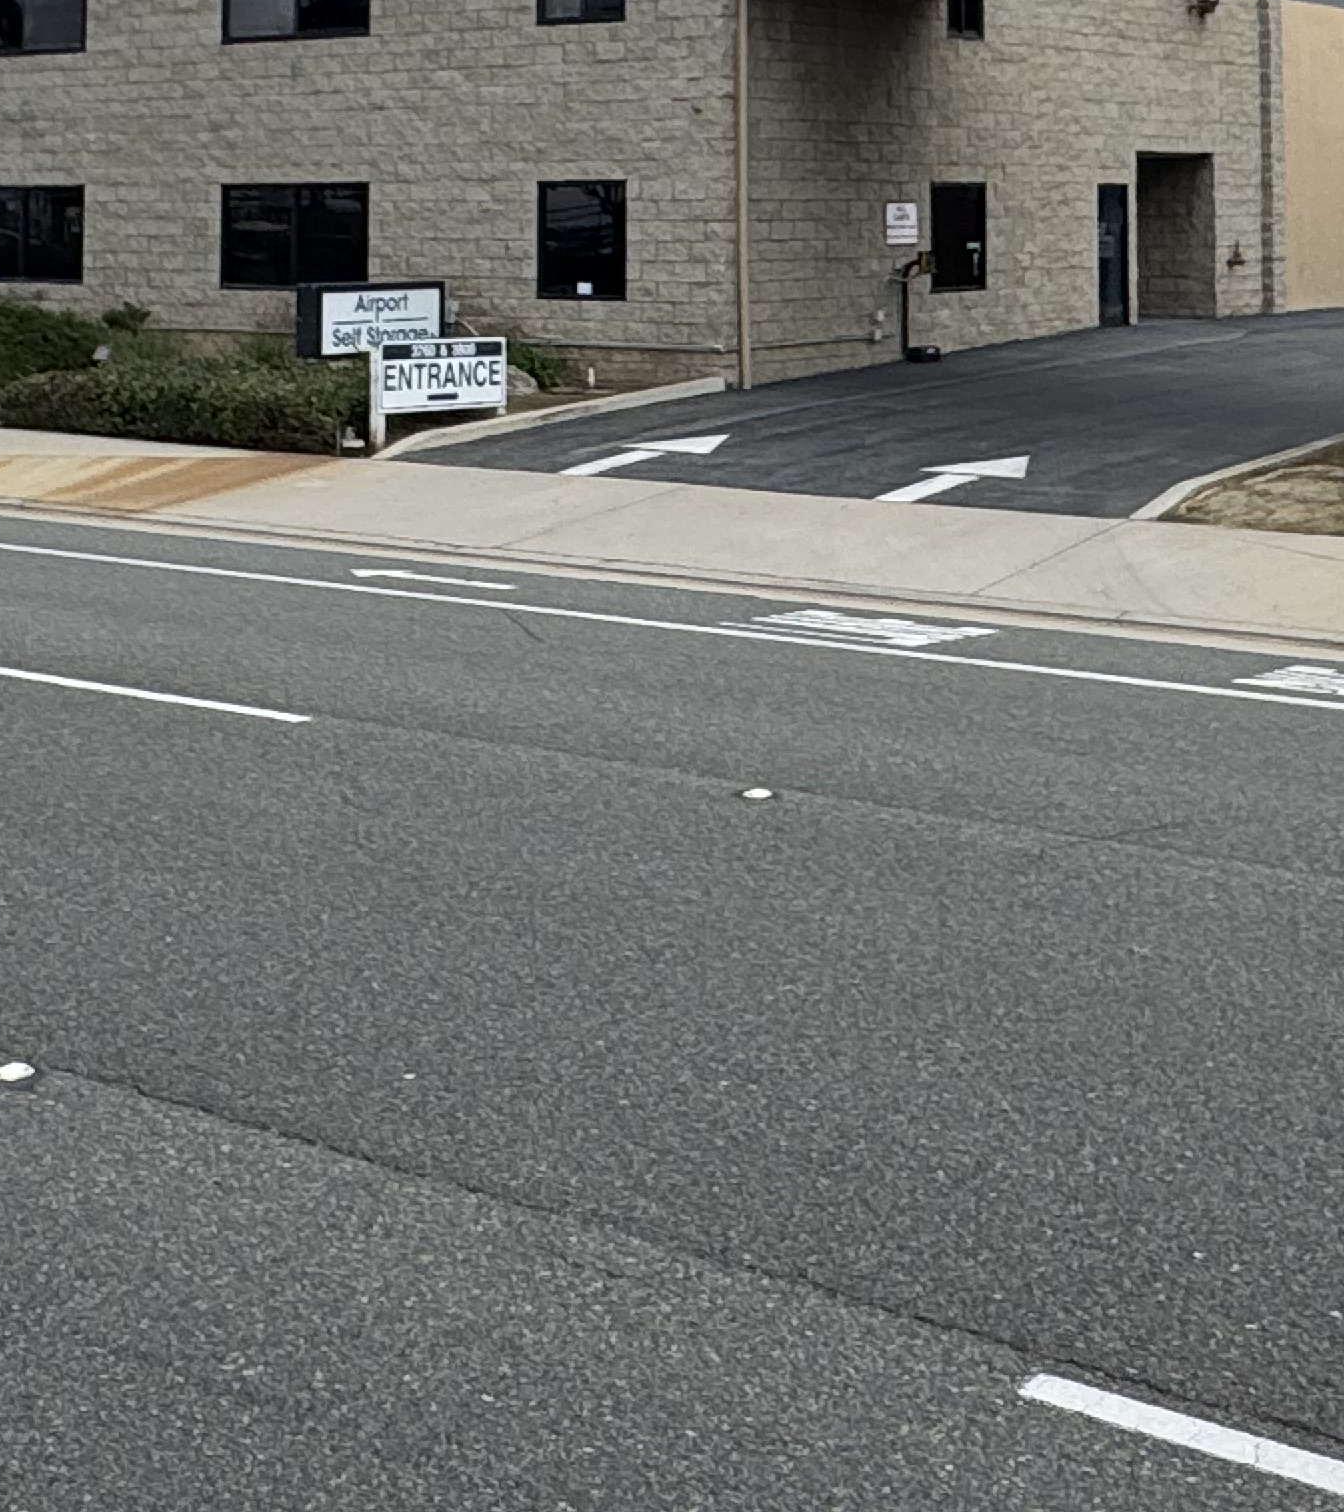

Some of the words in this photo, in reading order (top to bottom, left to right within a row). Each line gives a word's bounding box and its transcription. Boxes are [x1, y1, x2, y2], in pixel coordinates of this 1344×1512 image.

[353, 293, 409, 323] Airport
[332, 326, 362, 348] Self
[383, 359, 502, 392] ENTRANCE
